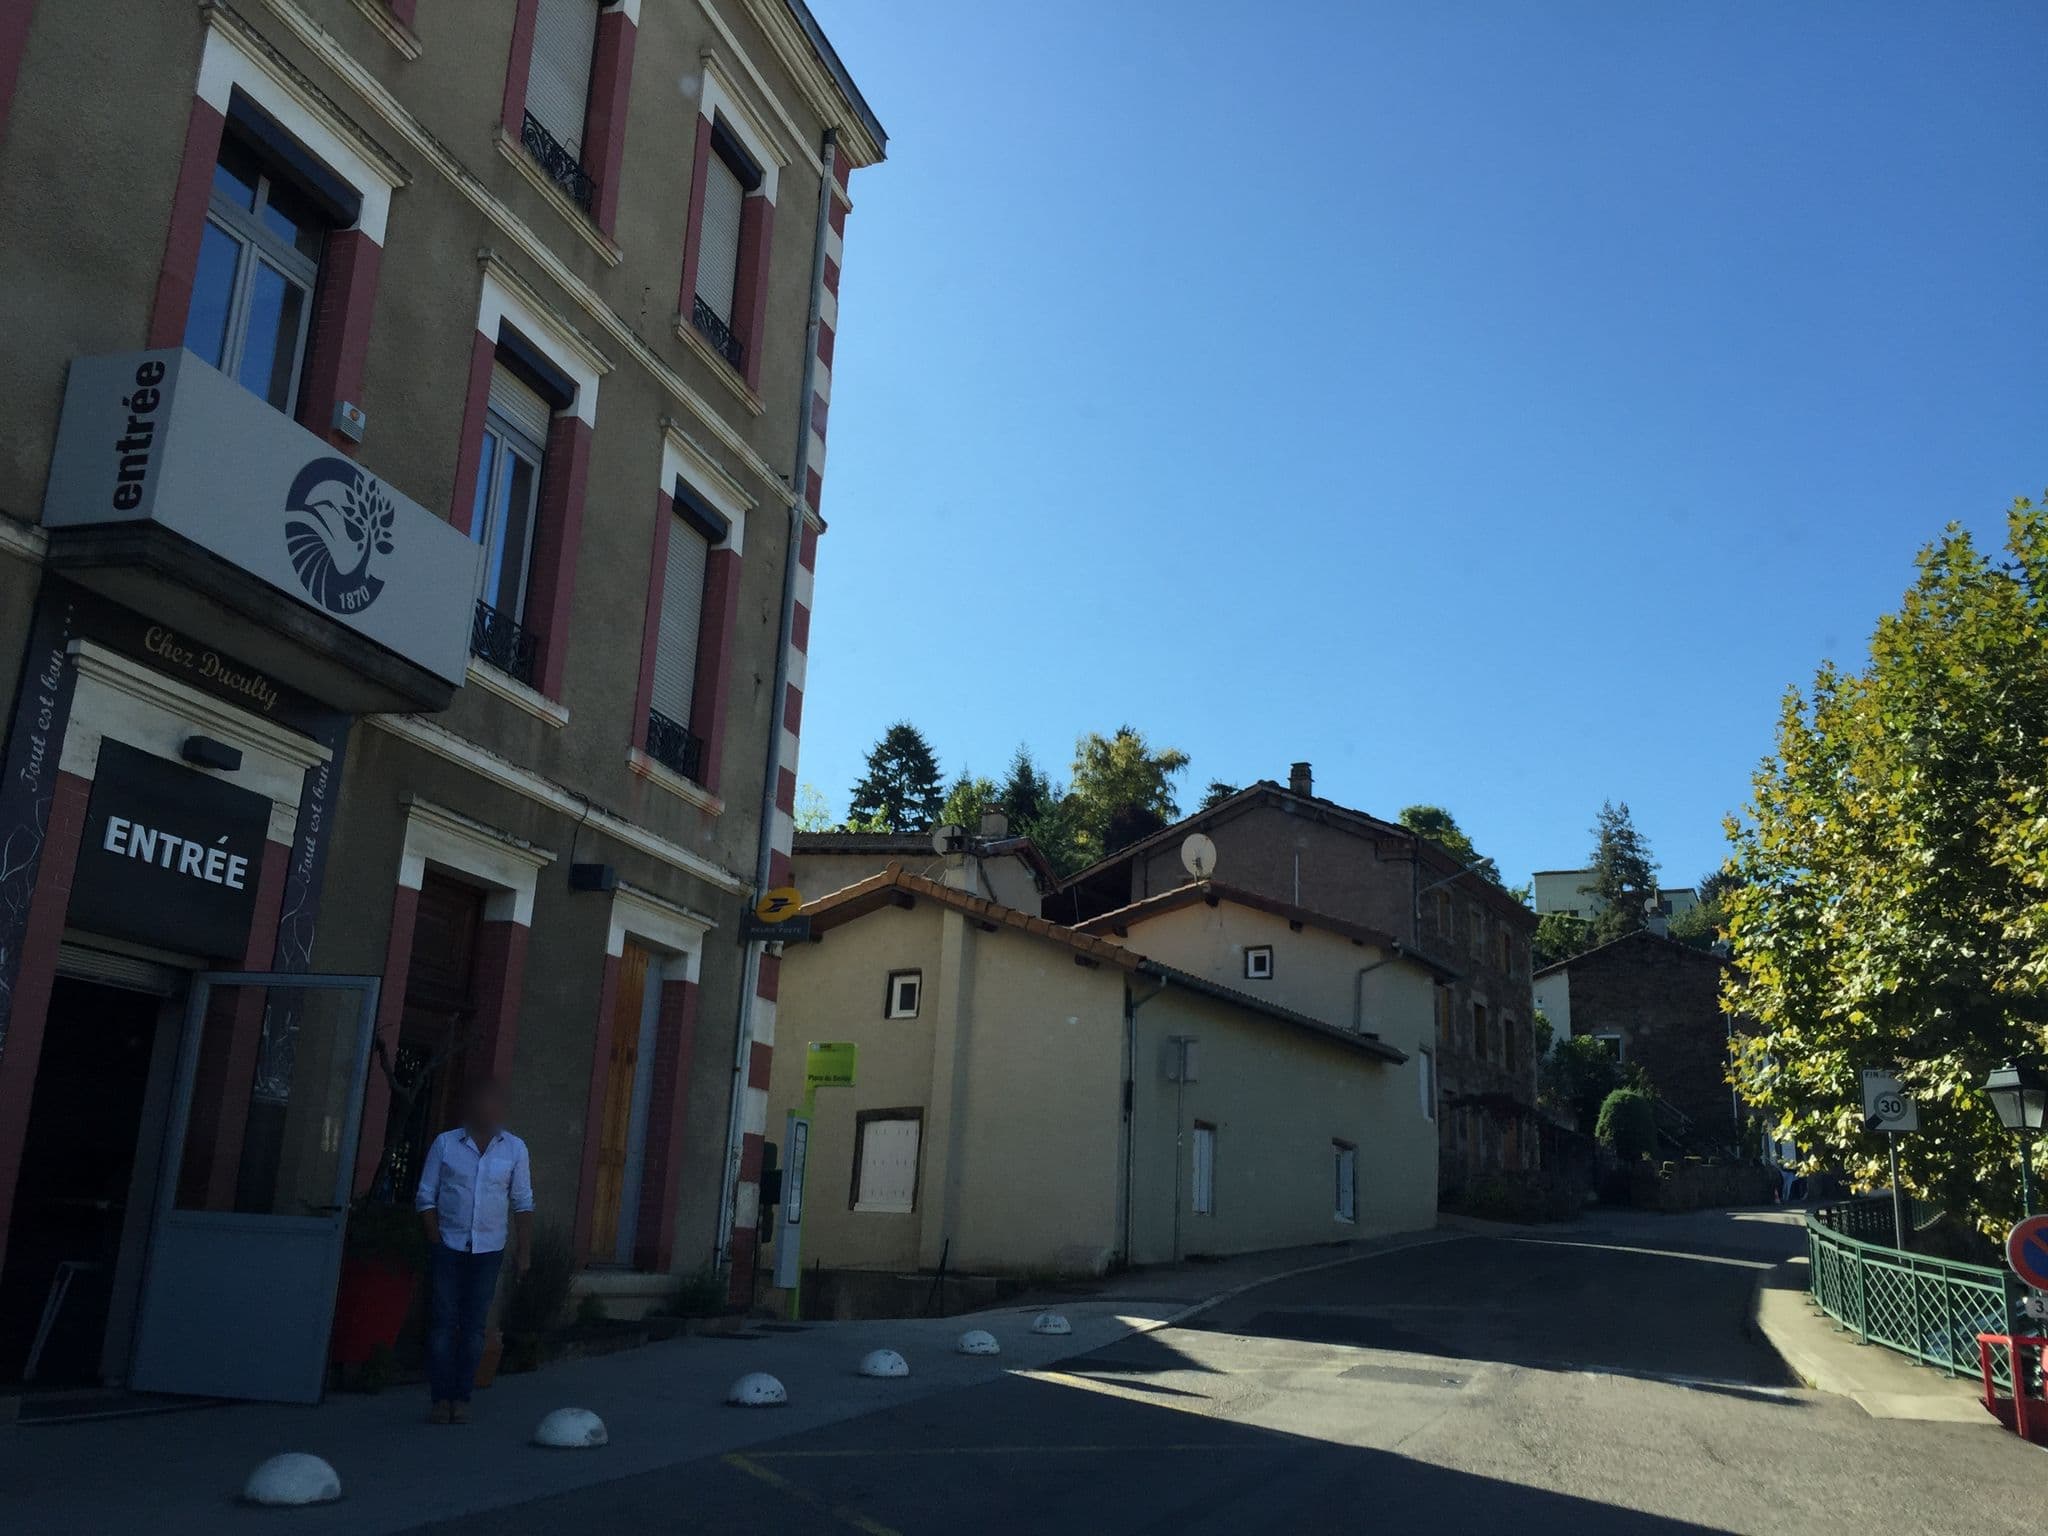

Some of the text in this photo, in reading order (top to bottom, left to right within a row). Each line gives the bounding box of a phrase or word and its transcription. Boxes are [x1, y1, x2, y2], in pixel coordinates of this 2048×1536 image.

[112, 360, 166, 511] entrée
[338, 586, 370, 610] 1870
[145, 626, 194, 668] Chez
[19, 734, 47, 794] Tout
[38, 695, 56, 732] est
[103, 815, 249, 890] ENTRÉE
[296, 834, 317, 886] Tout
[310, 802, 323, 833] est
[1865, 1071, 1879, 1079] FIN
[1881, 1100, 1901, 1113] 30
